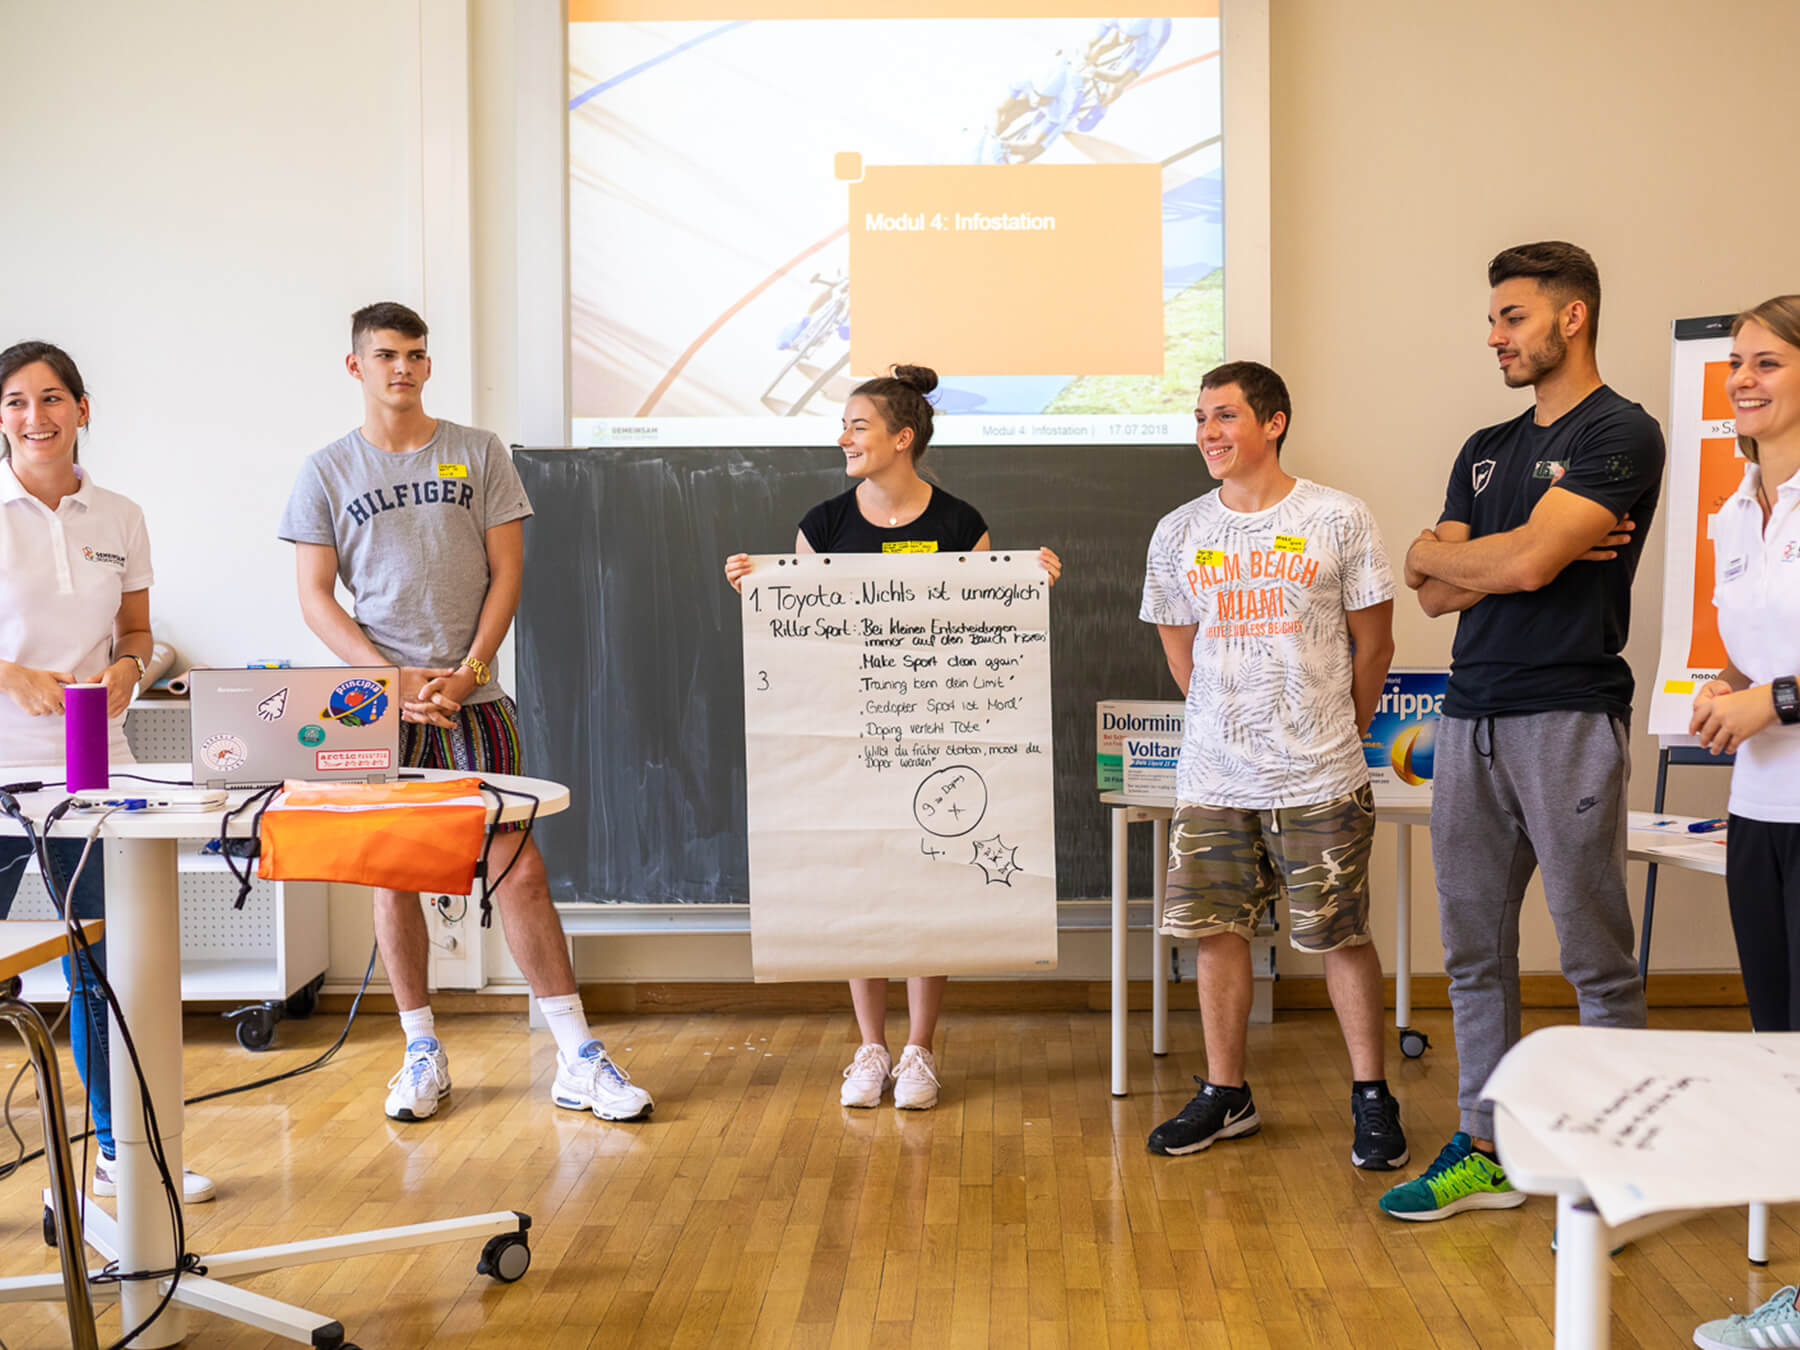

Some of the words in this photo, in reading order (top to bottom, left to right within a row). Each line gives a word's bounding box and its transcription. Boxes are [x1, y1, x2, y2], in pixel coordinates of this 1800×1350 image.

[865, 212, 925, 231] Modul
[929, 213, 950, 231] 4:
[955, 211, 1056, 231] Infostation
[982, 424, 1016, 436] Modul
[1032, 423, 1088, 436] Infostation
[346, 479, 475, 527] HILFIGER
[1186, 552, 1241, 597] PALM
[1250, 550, 1320, 588] BEACH
[927, 580, 951, 601] ist
[1217, 586, 1285, 622] MIAMI
[889, 616, 927, 635] kleinen
[912, 633, 938, 648] auf
[940, 631, 965, 644] den
[969, 633, 1007, 646] Bauch
[903, 654, 939, 672] Sport
[946, 655, 978, 668] clean
[945, 676, 969, 690] dein
[926, 697, 956, 715] Sport
[962, 701, 980, 711] ist
[1103, 712, 1182, 732] Dolormin
[894, 742, 910, 758] du
[1025, 741, 1043, 754] du
